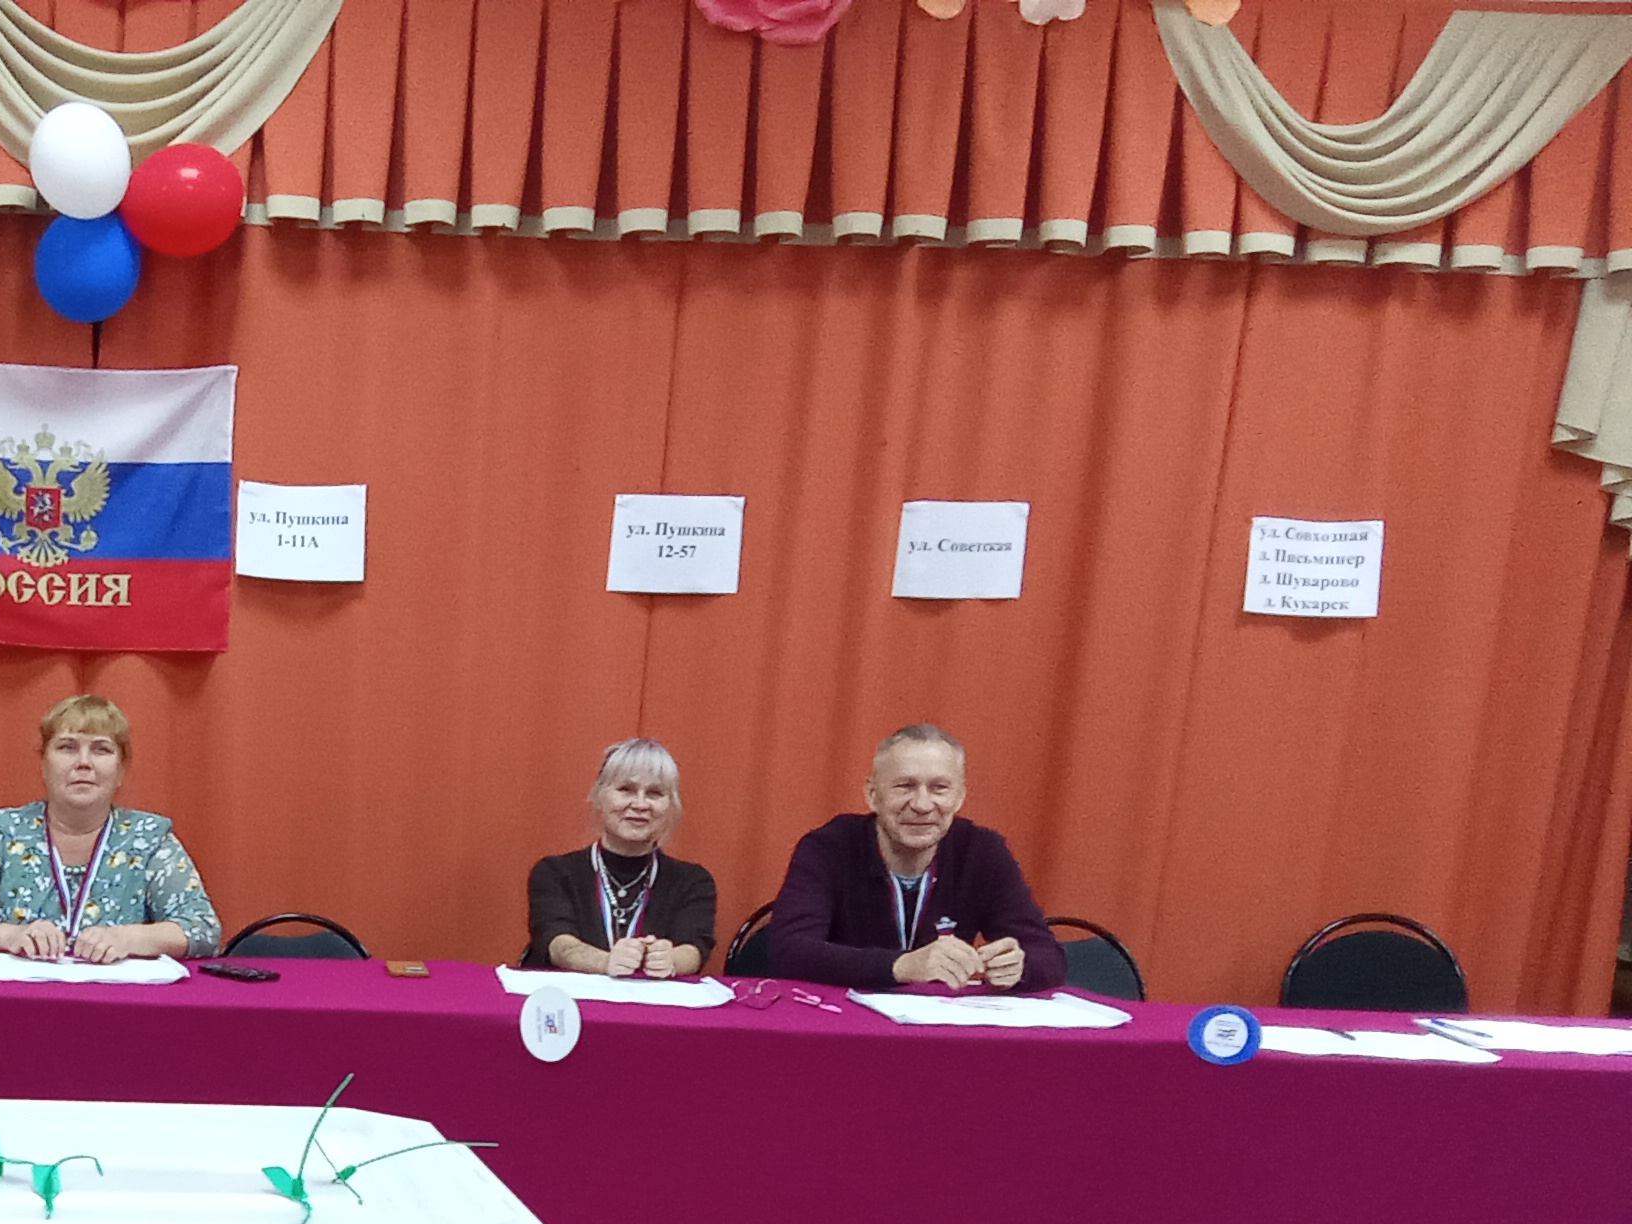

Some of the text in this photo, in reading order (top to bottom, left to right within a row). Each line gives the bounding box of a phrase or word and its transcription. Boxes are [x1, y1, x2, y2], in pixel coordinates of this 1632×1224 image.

[249, 511, 349, 528] ул. Пушкина
[626, 522, 726, 539] ул. Пушкина
[1285, 526, 1369, 543] Совхозная
[277, 533, 319, 548] 1-11А
[937, 538, 1013, 552] Советская
[657, 544, 697, 558] 12-57
[1276, 572, 1360, 591] Шуварово
[1281, 595, 1351, 613] Кукарск
